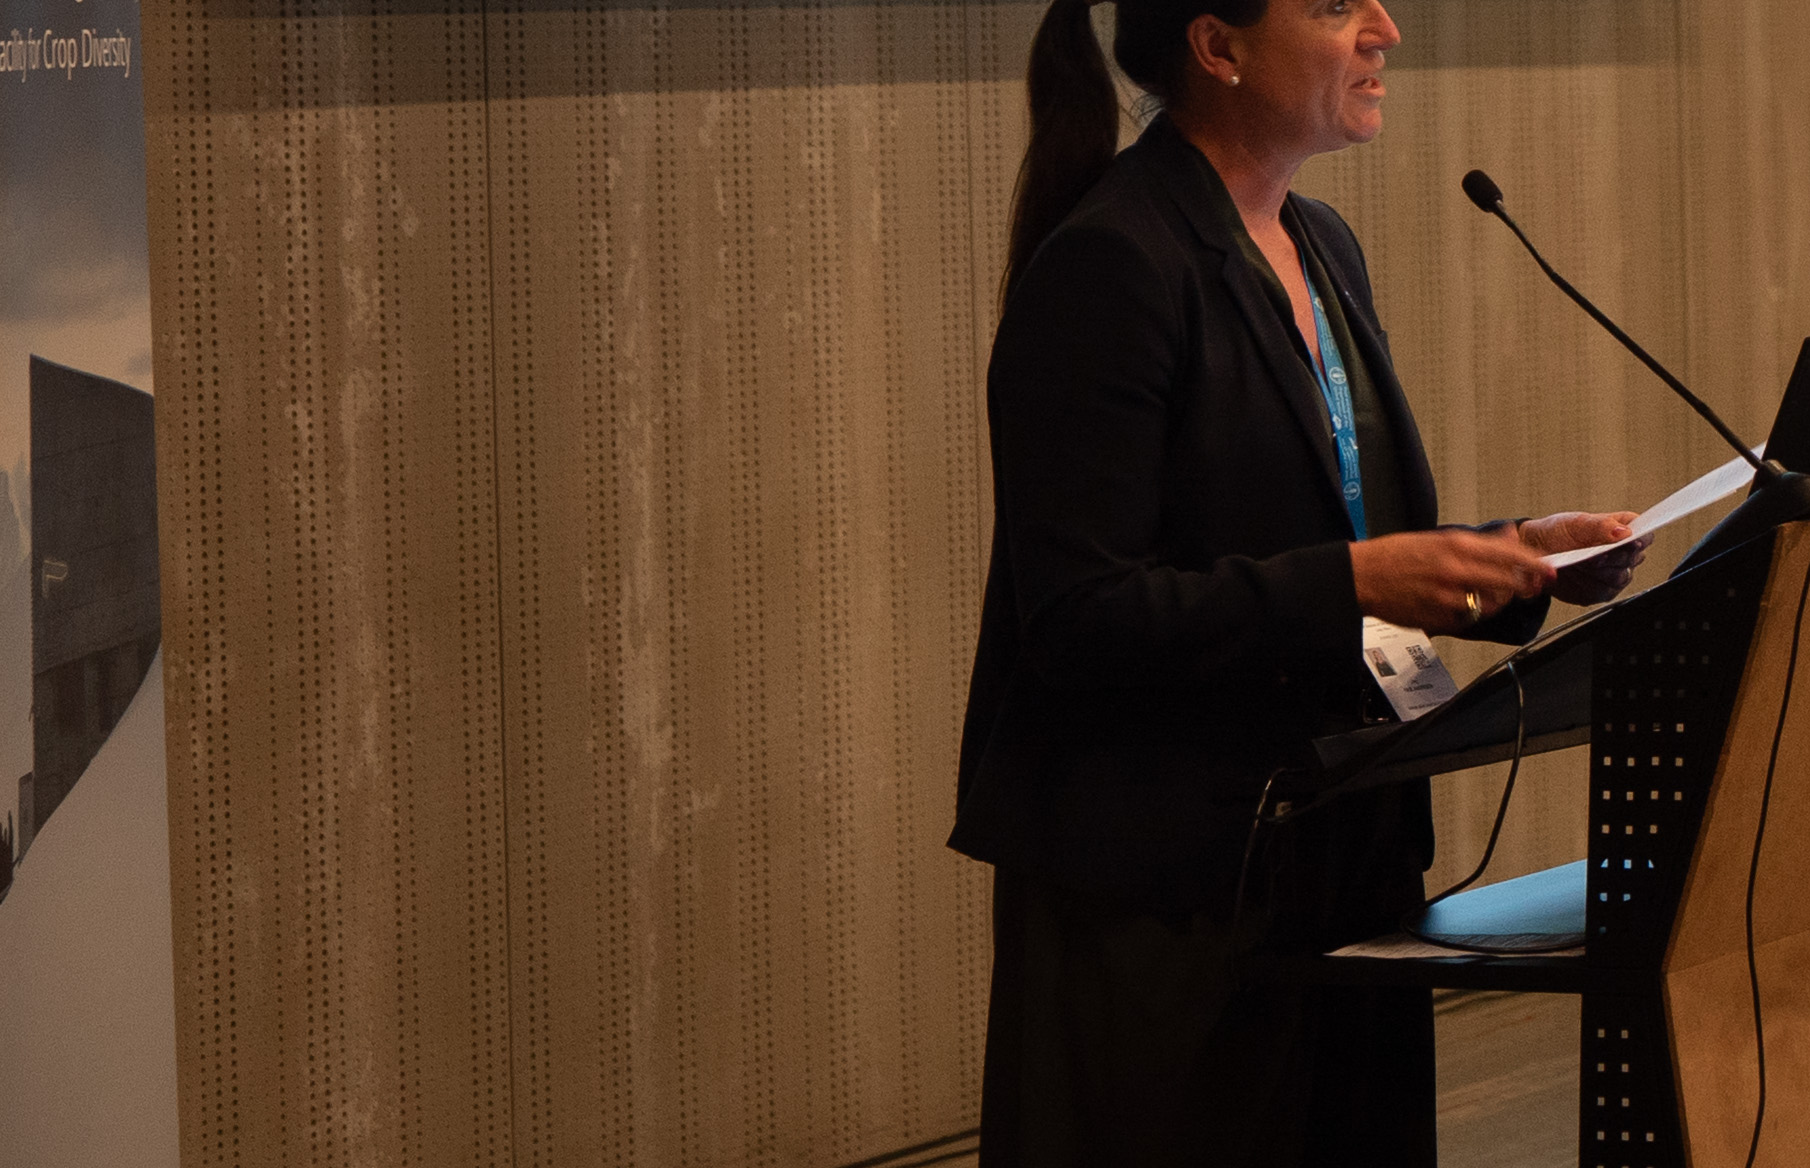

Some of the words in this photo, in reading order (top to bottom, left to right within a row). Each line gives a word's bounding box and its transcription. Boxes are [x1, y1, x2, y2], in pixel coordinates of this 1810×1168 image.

[28, 27, 41, 70] for
[43, 28, 77, 80] Crop
[82, 28, 131, 78] Diversity
